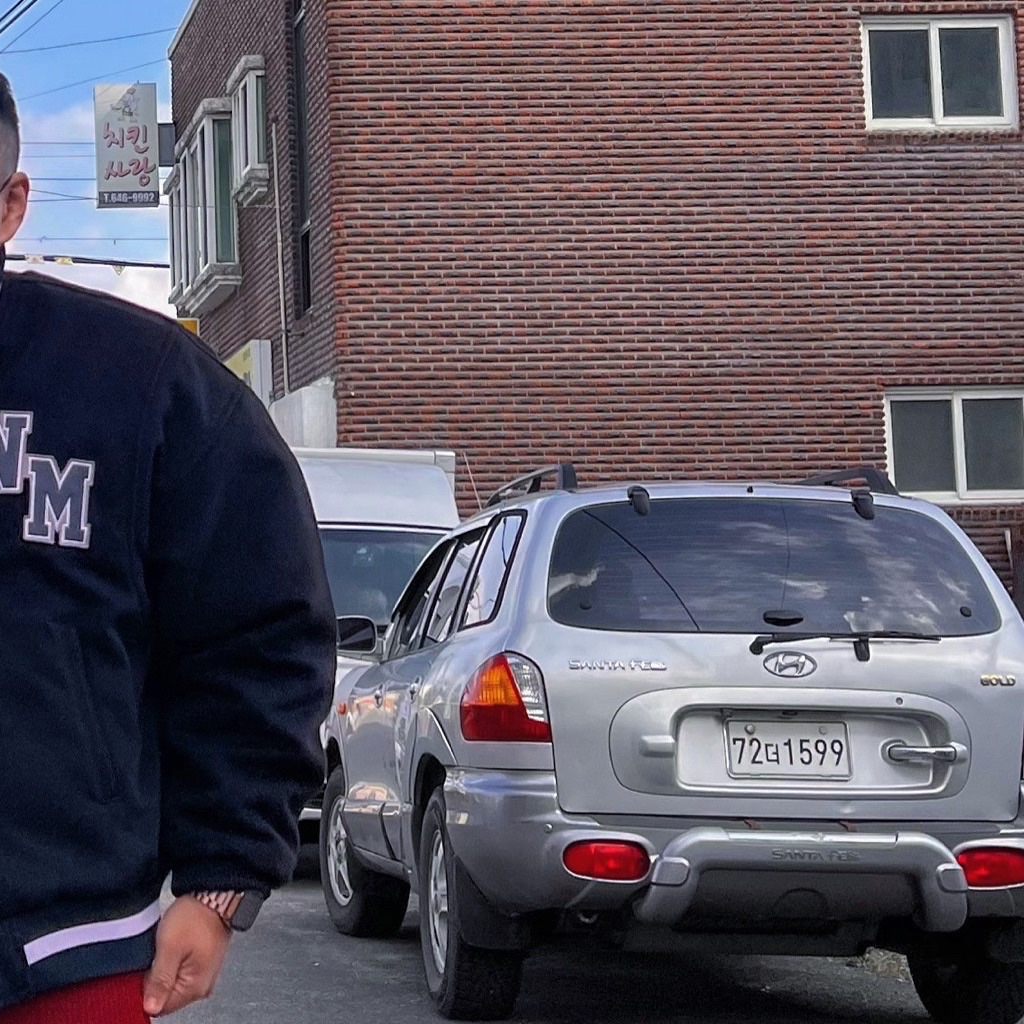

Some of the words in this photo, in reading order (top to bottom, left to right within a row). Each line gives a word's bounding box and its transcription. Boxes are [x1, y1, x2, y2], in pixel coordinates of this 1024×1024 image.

[103, 122, 149, 154] 치킨
[105, 157, 156, 187] 사랑
[569, 660, 625, 670] SANTA
[980, 674, 1016, 687] GOLD
[732, 737, 844, 767] 72더1599
[772, 848, 824, 860] SANTA
